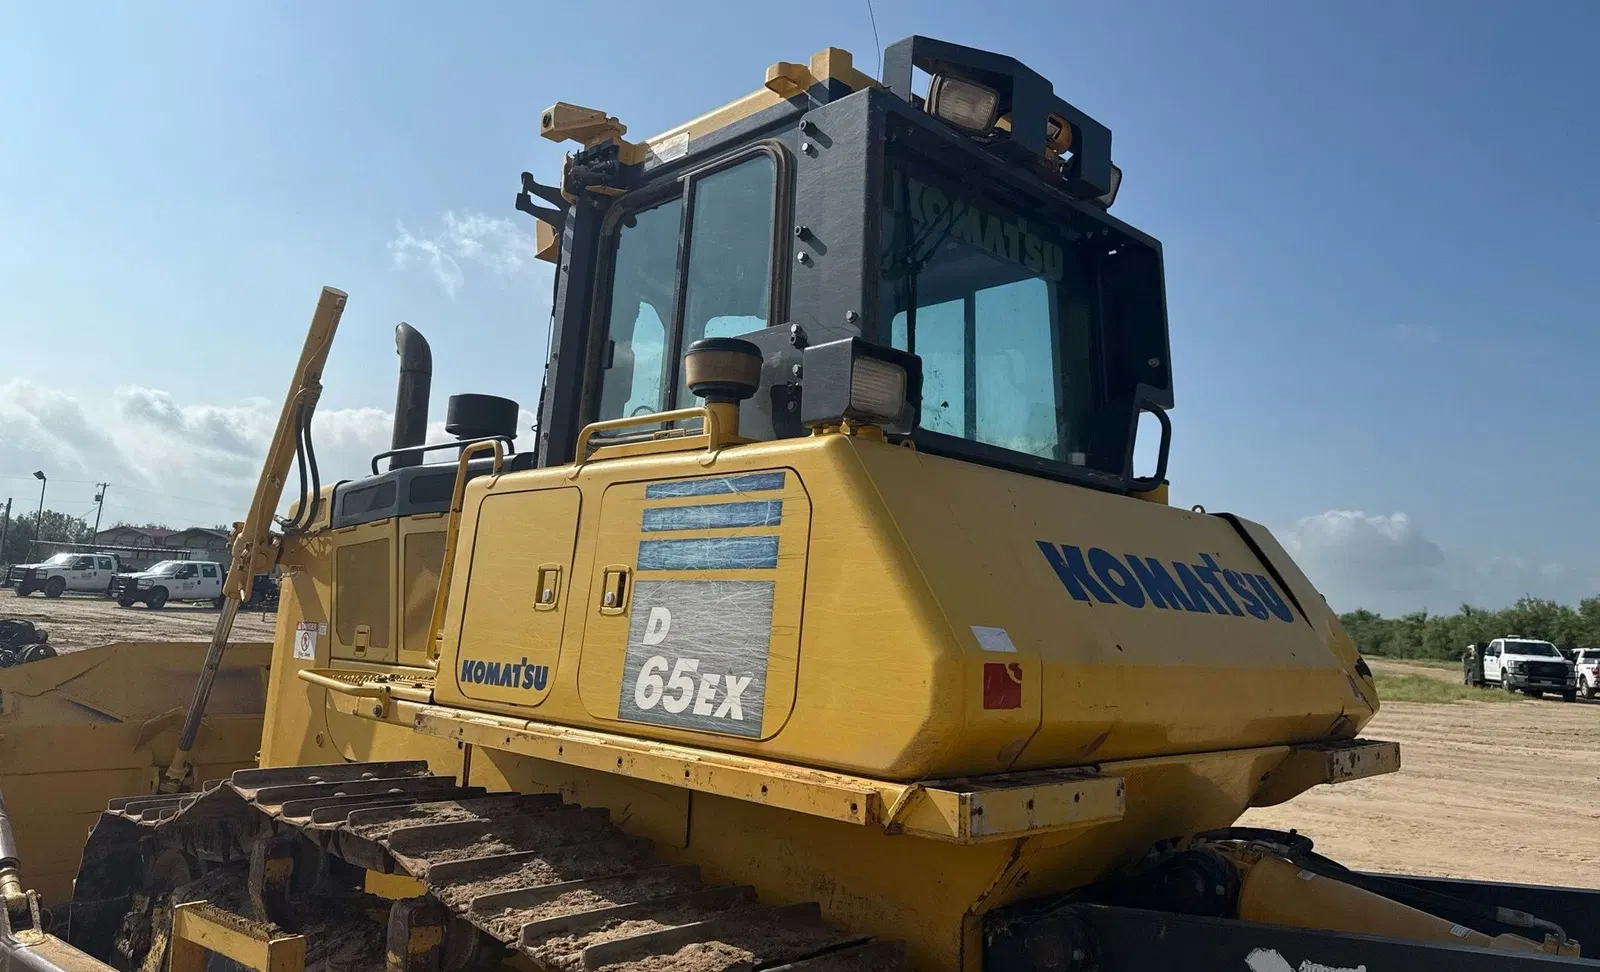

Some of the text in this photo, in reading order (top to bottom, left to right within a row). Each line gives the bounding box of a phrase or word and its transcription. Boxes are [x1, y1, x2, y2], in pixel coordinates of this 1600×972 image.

[1035, 540, 1294, 623] KOMATSU
[643, 607, 671, 645] D
[461, 657, 549, 691] KOMATSU
[634, 655, 753, 720] 65EX
